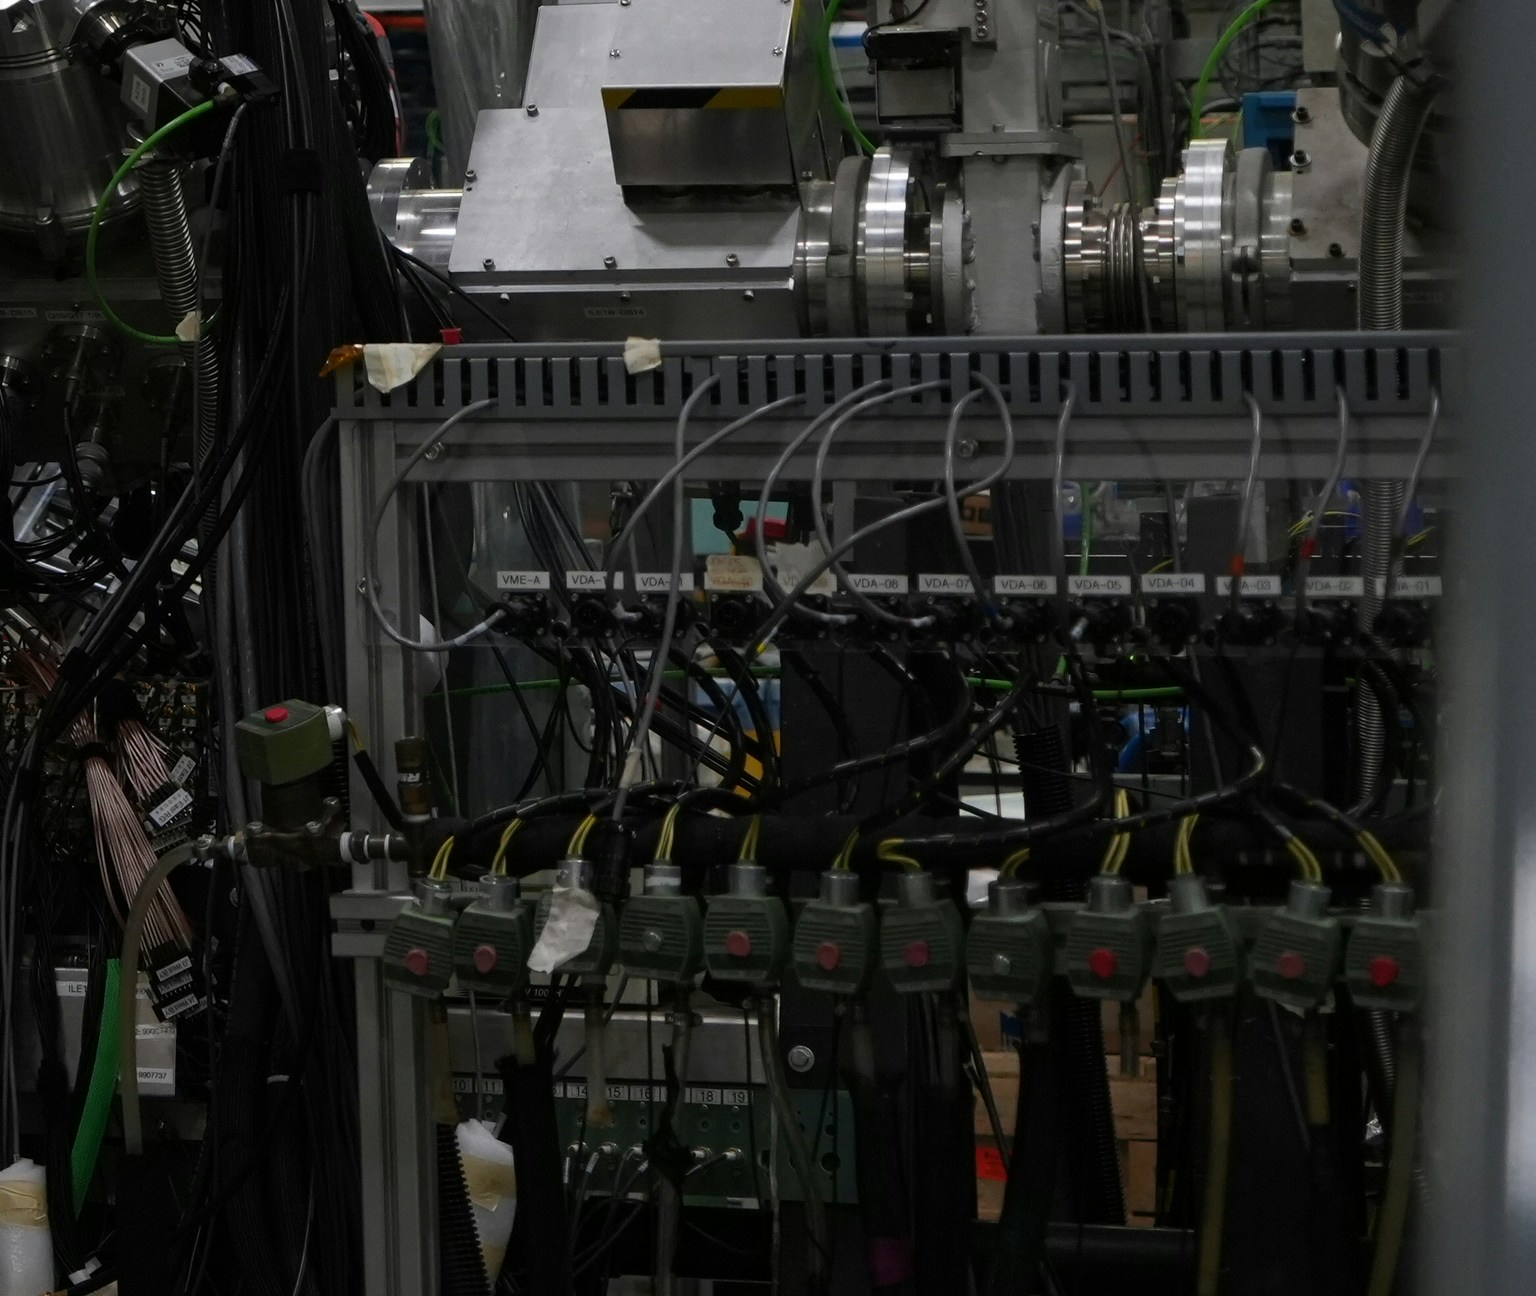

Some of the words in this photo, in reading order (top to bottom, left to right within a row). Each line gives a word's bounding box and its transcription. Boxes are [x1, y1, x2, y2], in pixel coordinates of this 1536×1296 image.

[501, 574, 541, 586] VME-A
[852, 577, 899, 589] VDA-08
[924, 577, 971, 589] VDA-07
[1000, 579, 1048, 591] VDA-06
[1074, 579, 1123, 591] VDA-05
[1147, 577, 1195, 589] VDA-04
[1224, 581, 1271, 591] VA-03
[484, 1081, 497, 1092] 11
[608, 1086, 621, 1098] 15
[700, 1089, 714, 1103] 18
[732, 1091, 745, 1104] 19
